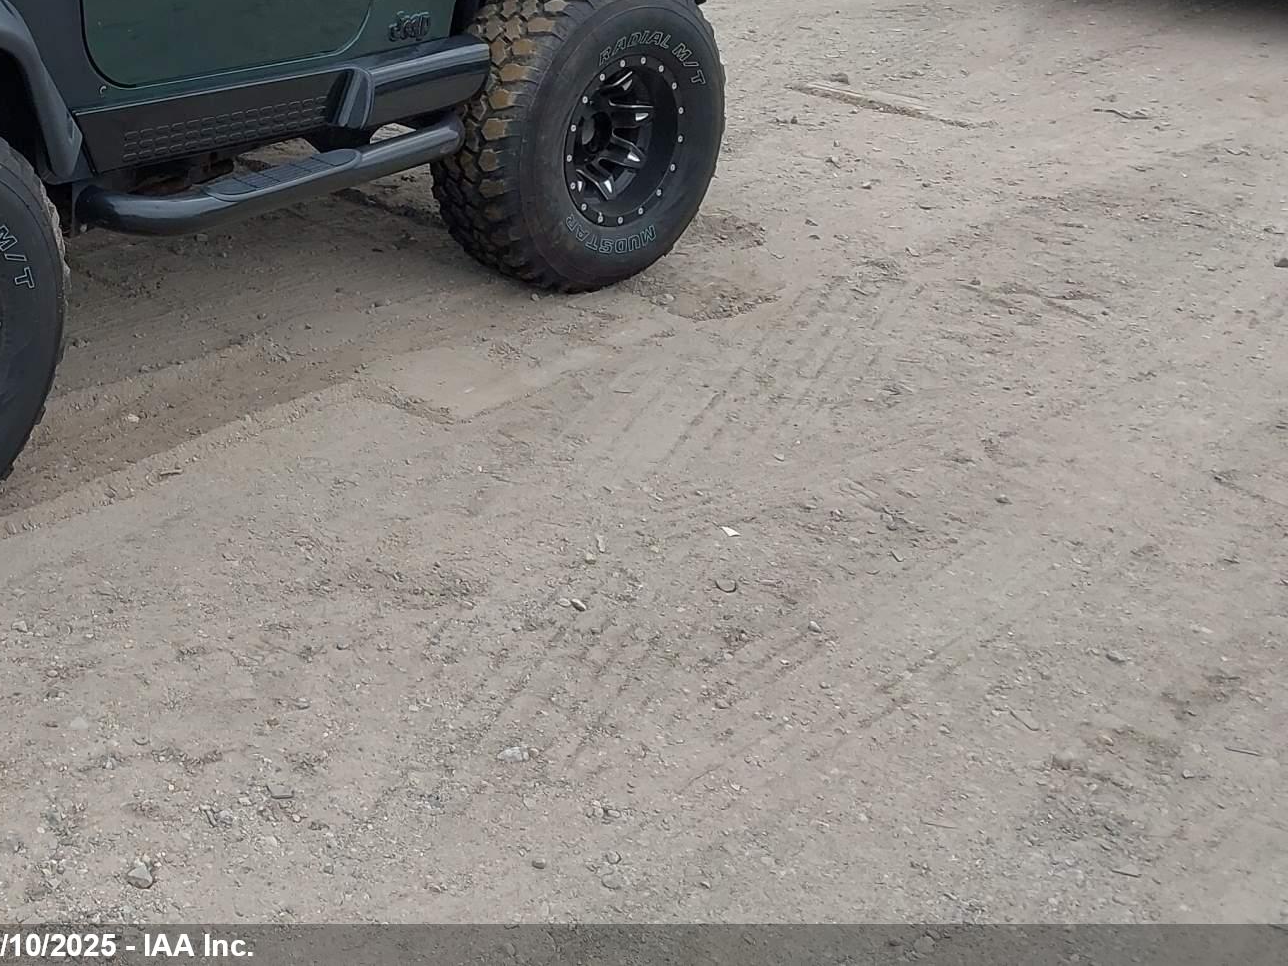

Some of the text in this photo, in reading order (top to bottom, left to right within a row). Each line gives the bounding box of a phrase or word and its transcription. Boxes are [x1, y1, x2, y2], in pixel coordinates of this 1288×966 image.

[598, 30, 706, 85] RADIAL M/T
[566, 214, 657, 254] MUDSTAR
